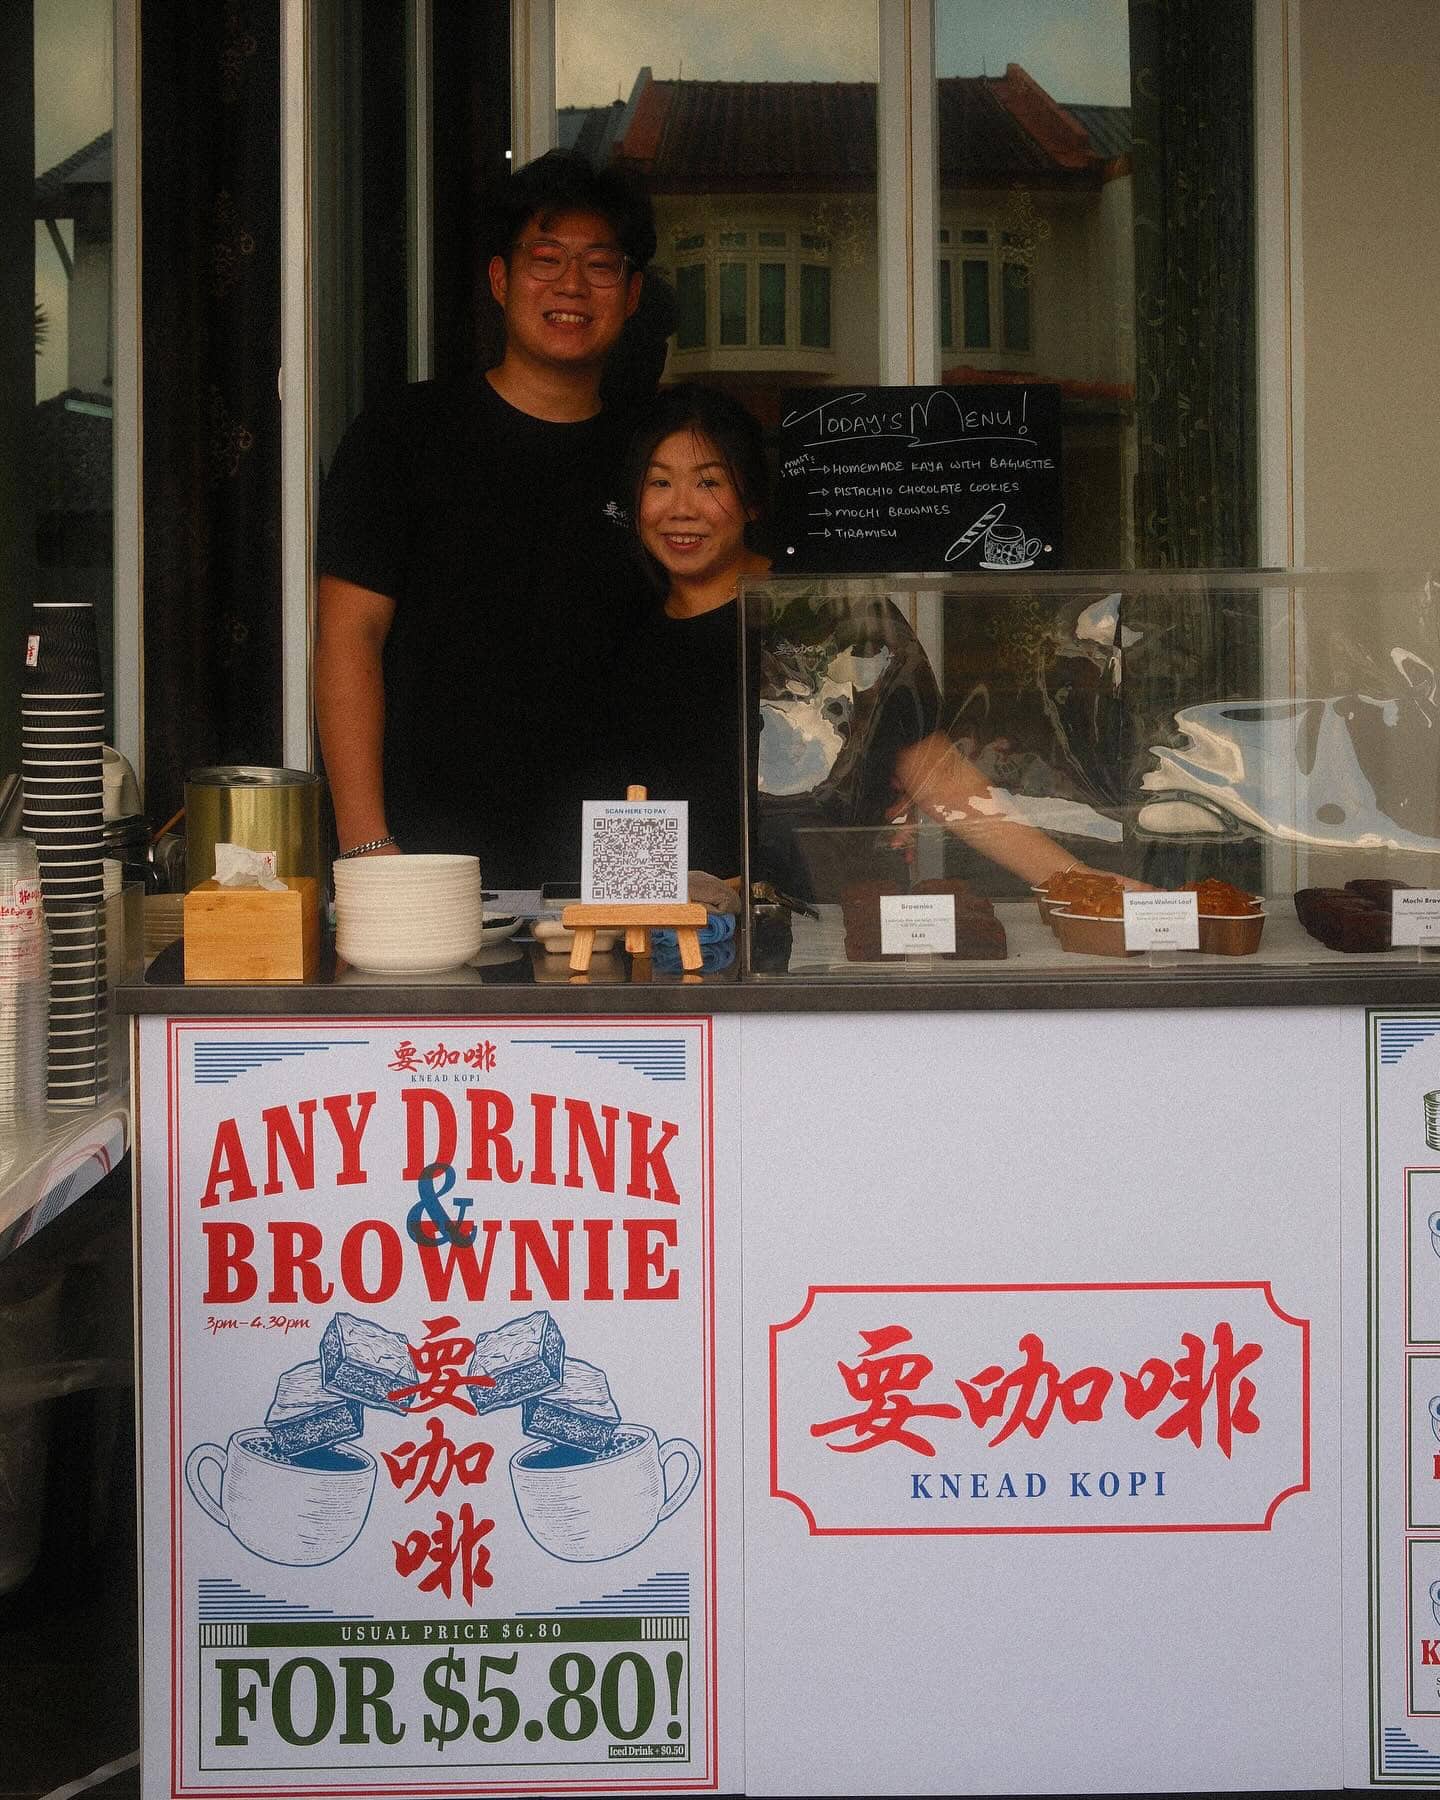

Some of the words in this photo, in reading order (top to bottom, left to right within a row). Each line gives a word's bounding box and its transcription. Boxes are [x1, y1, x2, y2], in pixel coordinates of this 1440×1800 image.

[782, 392, 902, 435] TODAY'S
[833, 461, 904, 474] HOMEMADE
[911, 461, 944, 472] KAYA
[950, 460, 981, 471] WITH
[990, 457, 1055, 470] BAGUETTE
[834, 485, 893, 497] PISTACHIO
[898, 483, 963, 494] CHOCOLATE
[969, 482, 1020, 493] COOKIES
[835, 508, 880, 518] MOCHI
[888, 504, 951, 517] BROWNIES
[835, 528, 897, 539] TIRAMISU
[411, 1074, 448, 1083] KNEAD
[454, 1074, 480, 1082] KOPI
[200, 1090, 377, 1209] ANY
[401, 1088, 680, 1206] DRINK
[406, 1162, 478, 1248] &
[203, 1219, 679, 1304] BROWNIE
[810, 1321, 1263, 1460] 要咖啡
[910, 1472, 1048, 1499] KNEAD
[1069, 1471, 1167, 1497] KOPI
[341, 1625, 410, 1641] USUAL
[423, 1624, 489, 1640] PRICE
[502, 1623, 561, 1639] $6.80
[215, 1656, 405, 1746] FOR
[423, 1647, 683, 1751] $5.80!
[610, 1746, 627, 1756] Iced
[629, 1745, 653, 1756] Drink
[661, 1745, 684, 1755] $0.50
